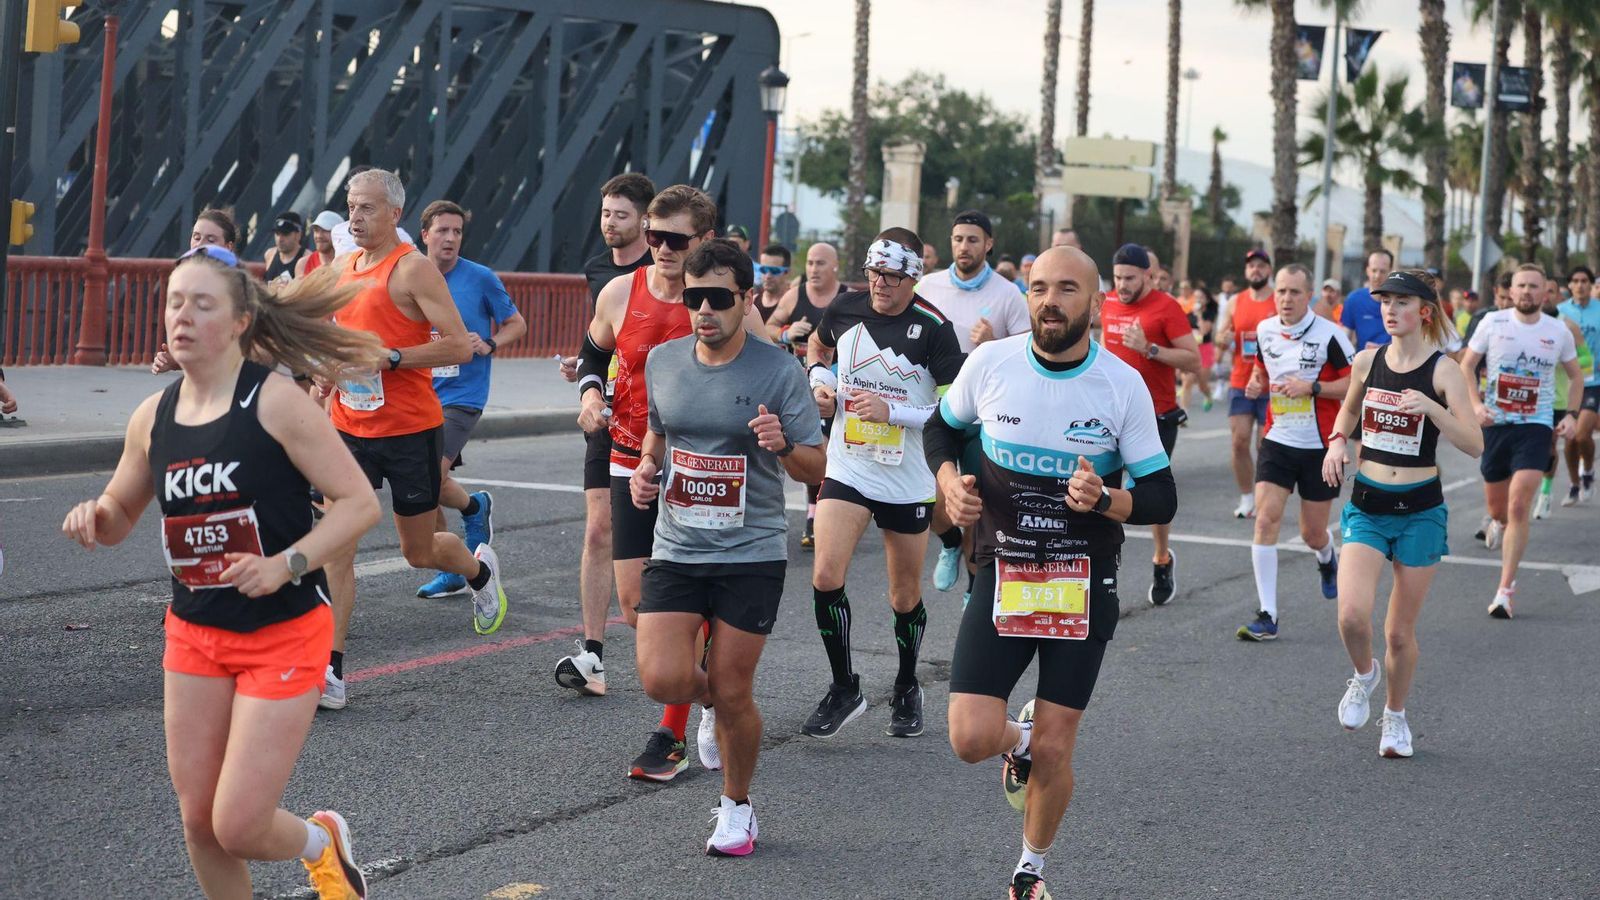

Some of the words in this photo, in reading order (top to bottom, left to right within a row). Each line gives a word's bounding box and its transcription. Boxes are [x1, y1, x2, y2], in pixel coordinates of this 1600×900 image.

[853, 376, 877, 391] Alpini
[878, 381, 908, 396] Sovere
[996, 413, 1021, 425] vive
[1372, 411, 1409, 428] 16935
[855, 422, 890, 437] 12532
[687, 456, 741, 471] GENERALI
[991, 439, 1079, 475] inacu
[165, 461, 241, 501] KICK
[681, 478, 727, 497] 10003
[690, 495, 713, 503] CARLOS
[1020, 514, 1065, 529] AMG
[184, 524, 229, 546] 4753
[193, 544, 224, 555] KRISTIAN
[1023, 561, 1083, 573] GENERALI
[1022, 585, 1065, 603] 5751
